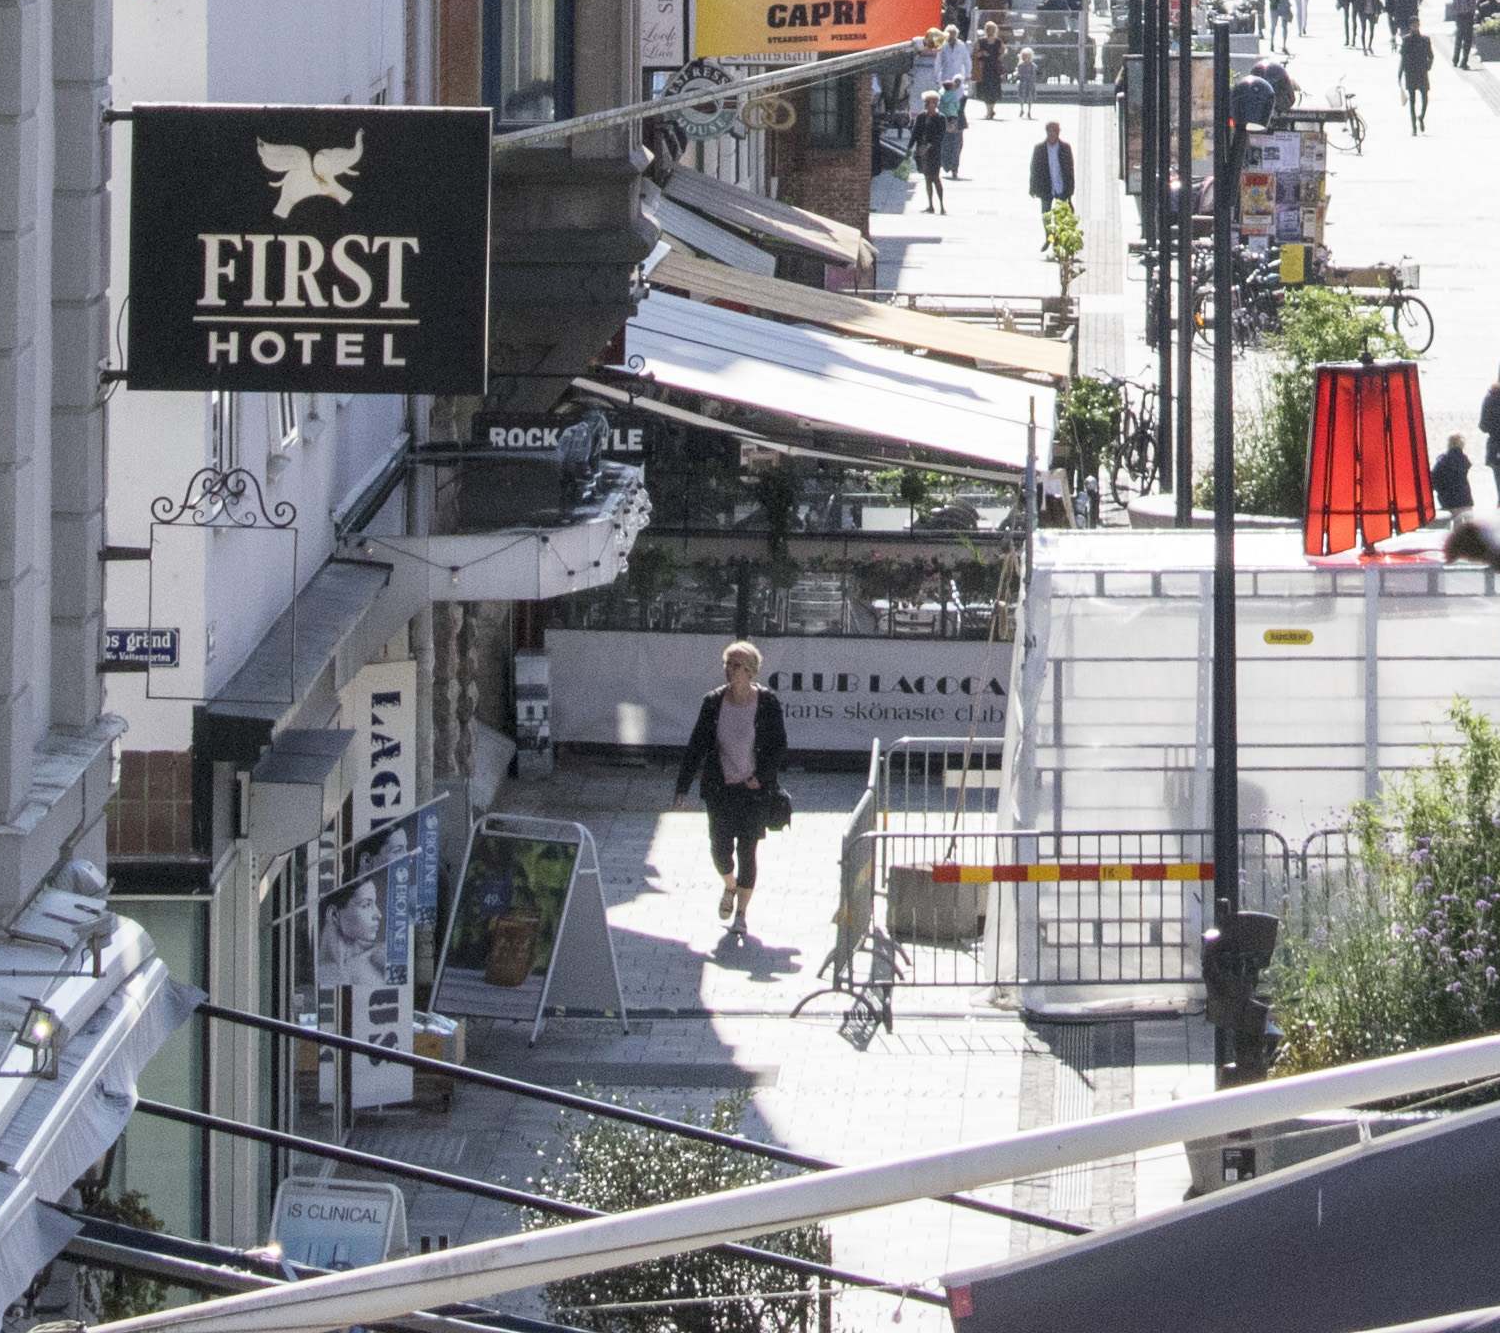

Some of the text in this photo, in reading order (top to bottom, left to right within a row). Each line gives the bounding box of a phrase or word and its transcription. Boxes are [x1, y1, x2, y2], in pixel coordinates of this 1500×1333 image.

[767, 0, 867, 28] CAPRI
[767, 34, 818, 44] STEAKHOUSE
[196, 233, 420, 310] FIRST
[207, 330, 408, 367] HOTEL
[768, 671, 1007, 696] CLUB LACOCA
[843, 701, 945, 721] skönaste
[954, 702, 1004, 723] club
[307, 1203, 382, 1224] CLINICAL
